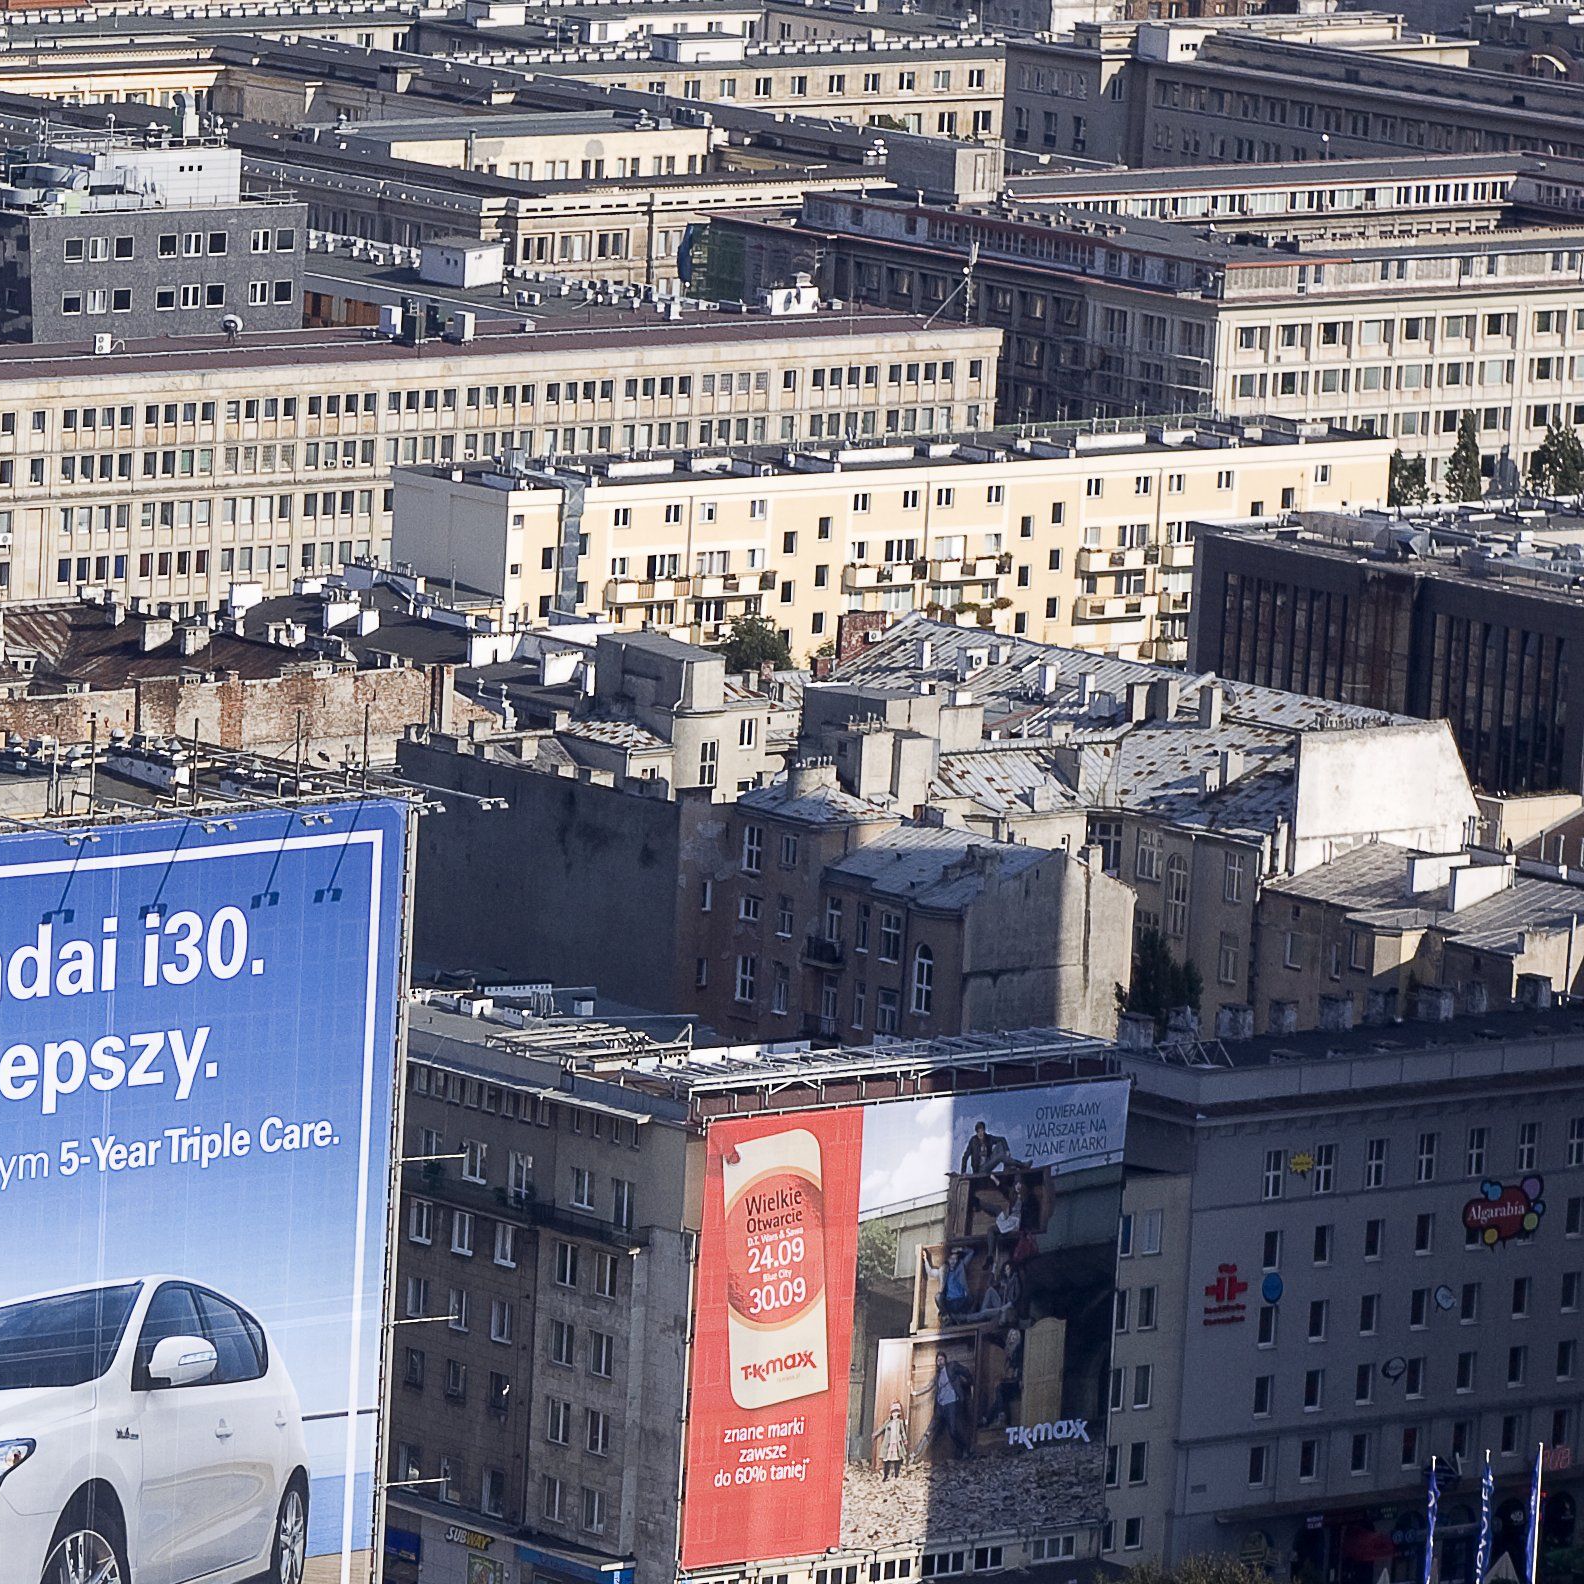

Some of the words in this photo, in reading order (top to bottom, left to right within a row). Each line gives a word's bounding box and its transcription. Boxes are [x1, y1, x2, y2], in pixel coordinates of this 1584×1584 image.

[143, 906, 265, 988] i30.
[1035, 1101, 1101, 1121] OTWIERAMY
[1089, 1118, 1107, 1133] NA
[59, 1138, 162, 1178] 5-Year
[166, 1126, 250, 1169] Triple
[259, 1115, 341, 1155] Care.
[1025, 1140, 1065, 1158] ZNANE
[1068, 1136, 1107, 1153] MARKI
[745, 1187, 803, 1217] Wielkie
[746, 1207, 803, 1234] Otwarcie
[747, 1236, 805, 1274] 24.09
[749, 1276, 807, 1314] 30.09
[723, 1425, 765, 1444] znane
[767, 1416, 805, 1439] marki
[738, 1443, 788, 1463] zawsze
[713, 1468, 732, 1488] do
[735, 1465, 767, 1485] 60%
[445, 1526, 495, 1550] SUBWAY
